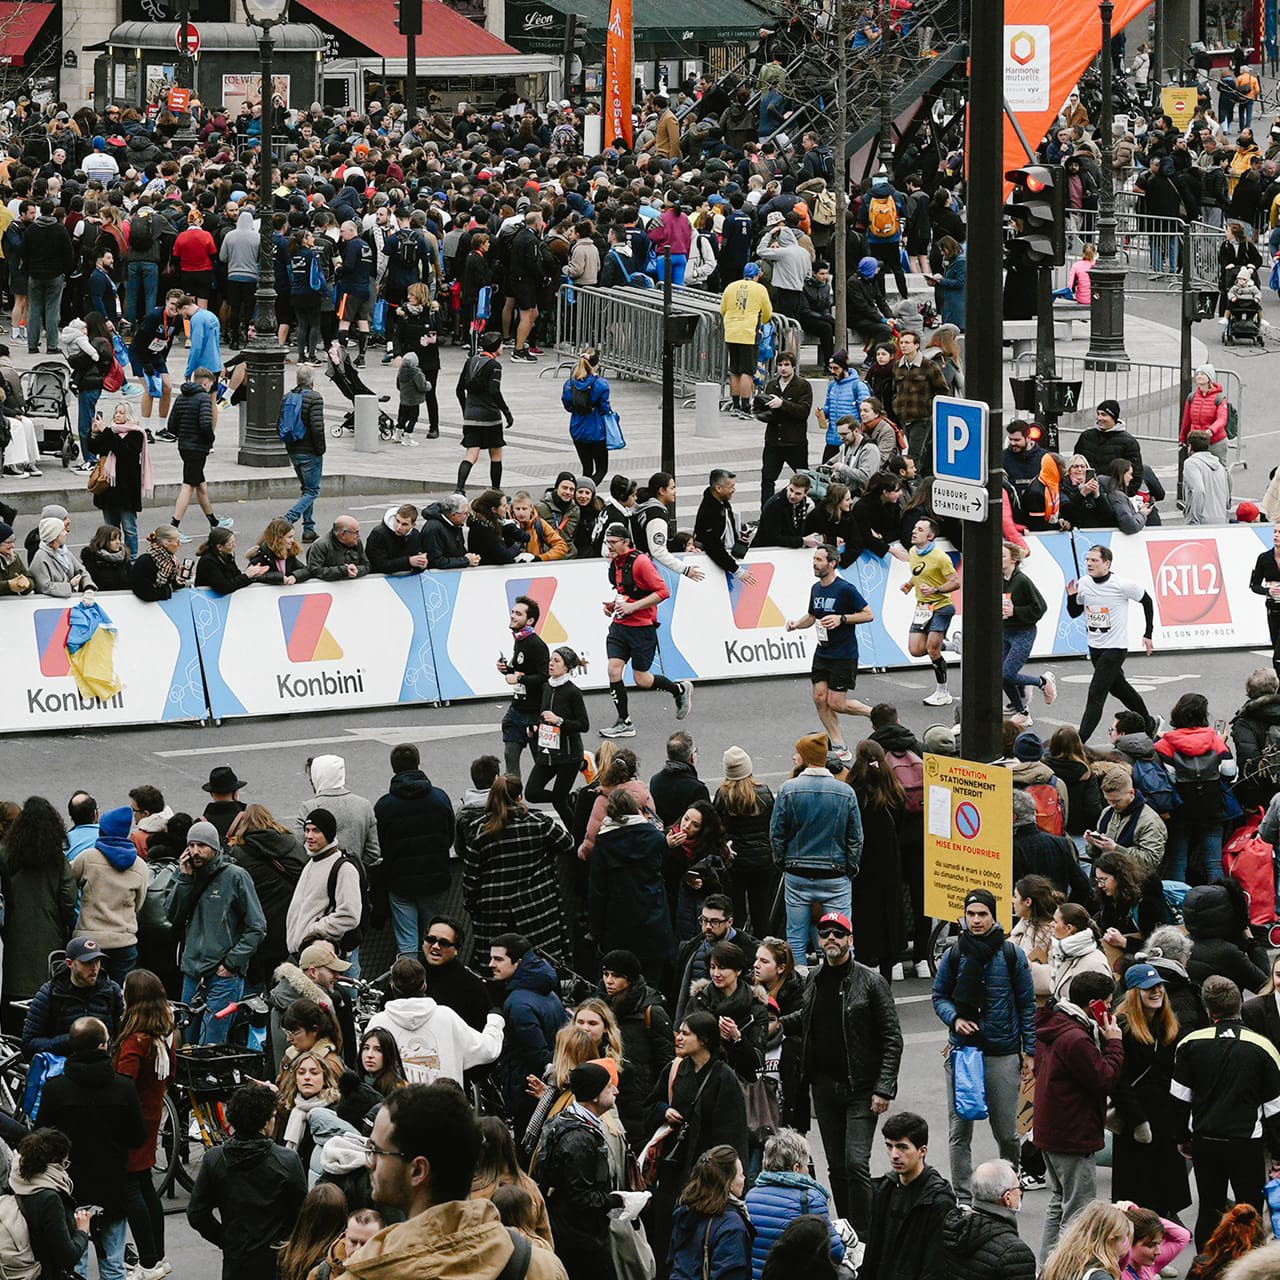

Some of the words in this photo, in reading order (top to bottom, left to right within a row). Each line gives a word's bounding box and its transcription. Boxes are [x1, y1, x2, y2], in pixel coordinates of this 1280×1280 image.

[947, 415, 970, 464] P
[934, 487, 968, 500] FAUBOURG
[934, 500, 971, 513] ST-ANTOINE
[1160, 563, 1220, 596] RTL2
[725, 635, 807, 664] Konbini
[277, 669, 364, 699] Konbini
[948, 767, 987, 780] ATTENTION
[939, 774, 997, 792] STATIONNEMENT
[952, 786, 983, 799] INTERDIT
[935, 839, 951, 851] MISE
[952, 843, 962, 852] EN
[942, 861, 960, 871] samedi
[966, 867, 978, 875] mars
[983, 869, 1001, 880] 00h00
[941, 871, 964, 883] dimanche
[969, 878, 982, 887] mars
[987, 880, 1003, 890] 17h00
